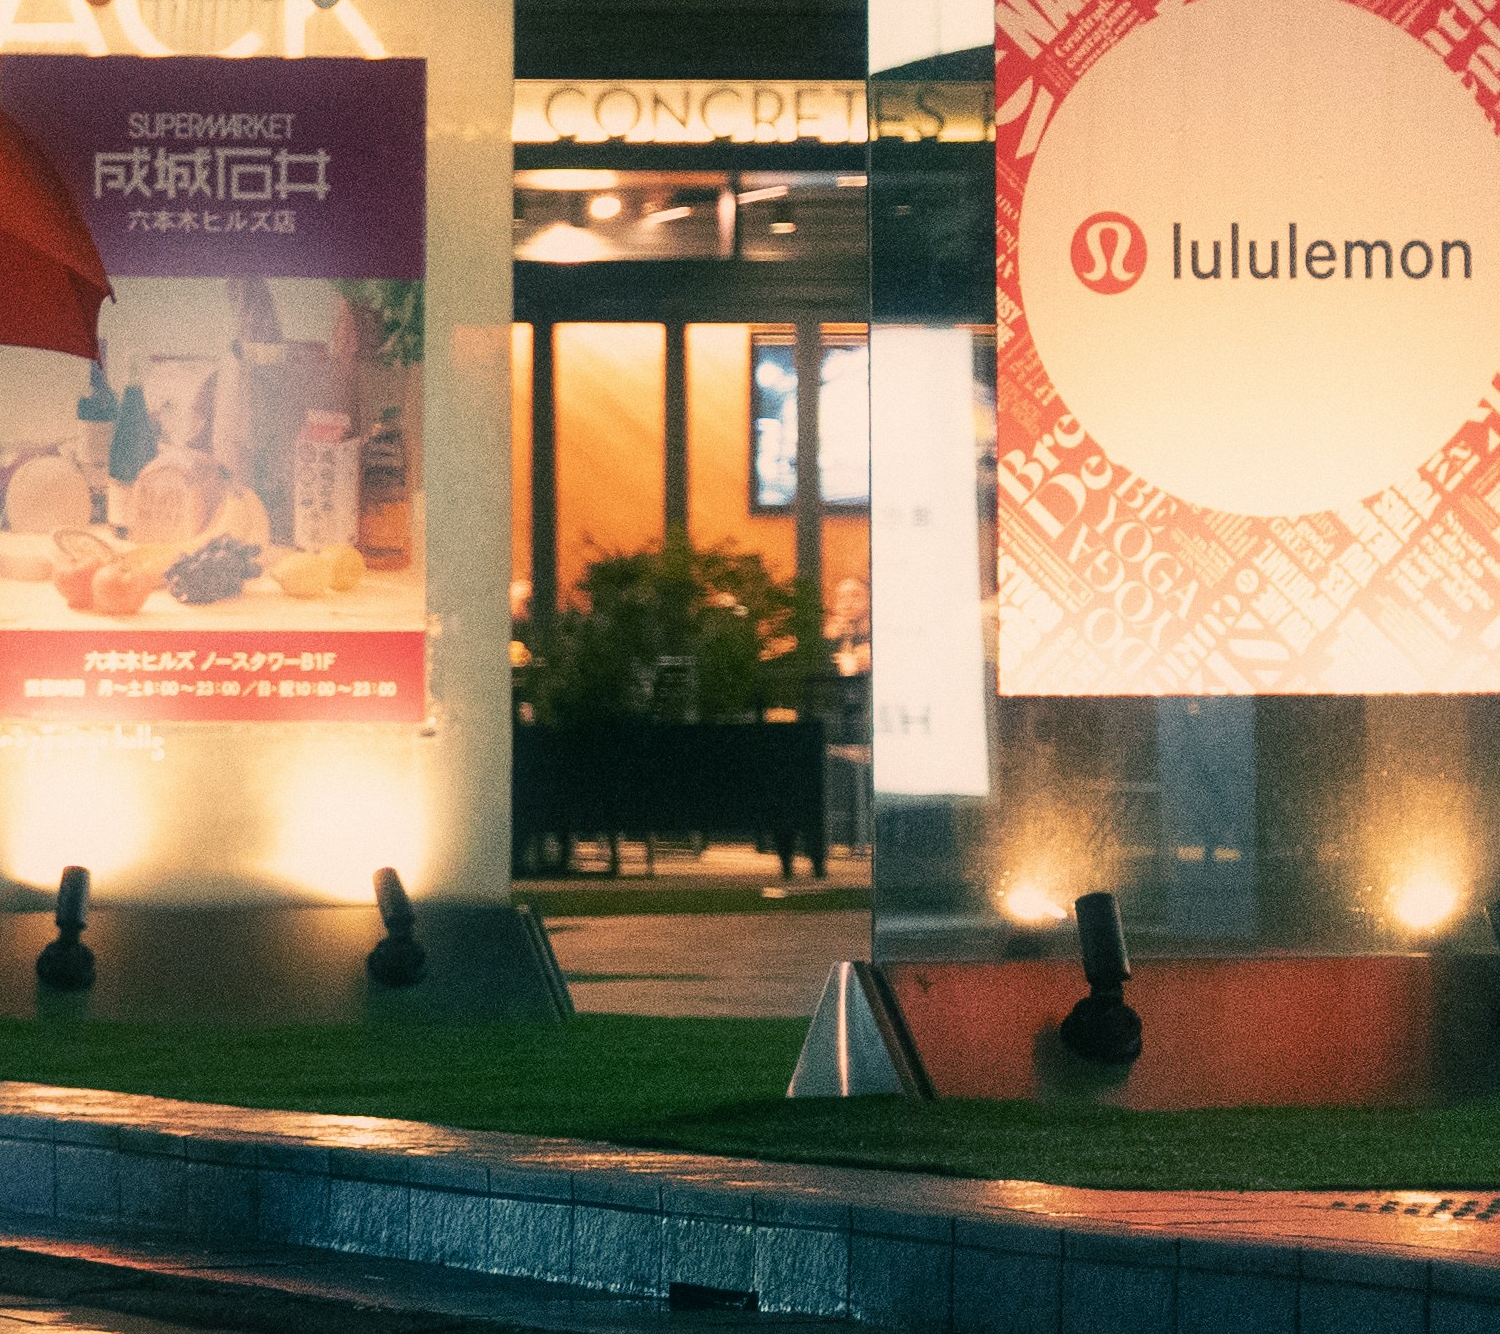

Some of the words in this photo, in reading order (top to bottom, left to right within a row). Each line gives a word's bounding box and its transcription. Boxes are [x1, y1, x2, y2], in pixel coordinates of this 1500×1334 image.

[128, 112, 296, 139] SUPERMARKET
[94, 148, 331, 200] 成城石井
[1172, 222, 1473, 280] lululemon
[1095, 496, 1199, 620] YOGA
